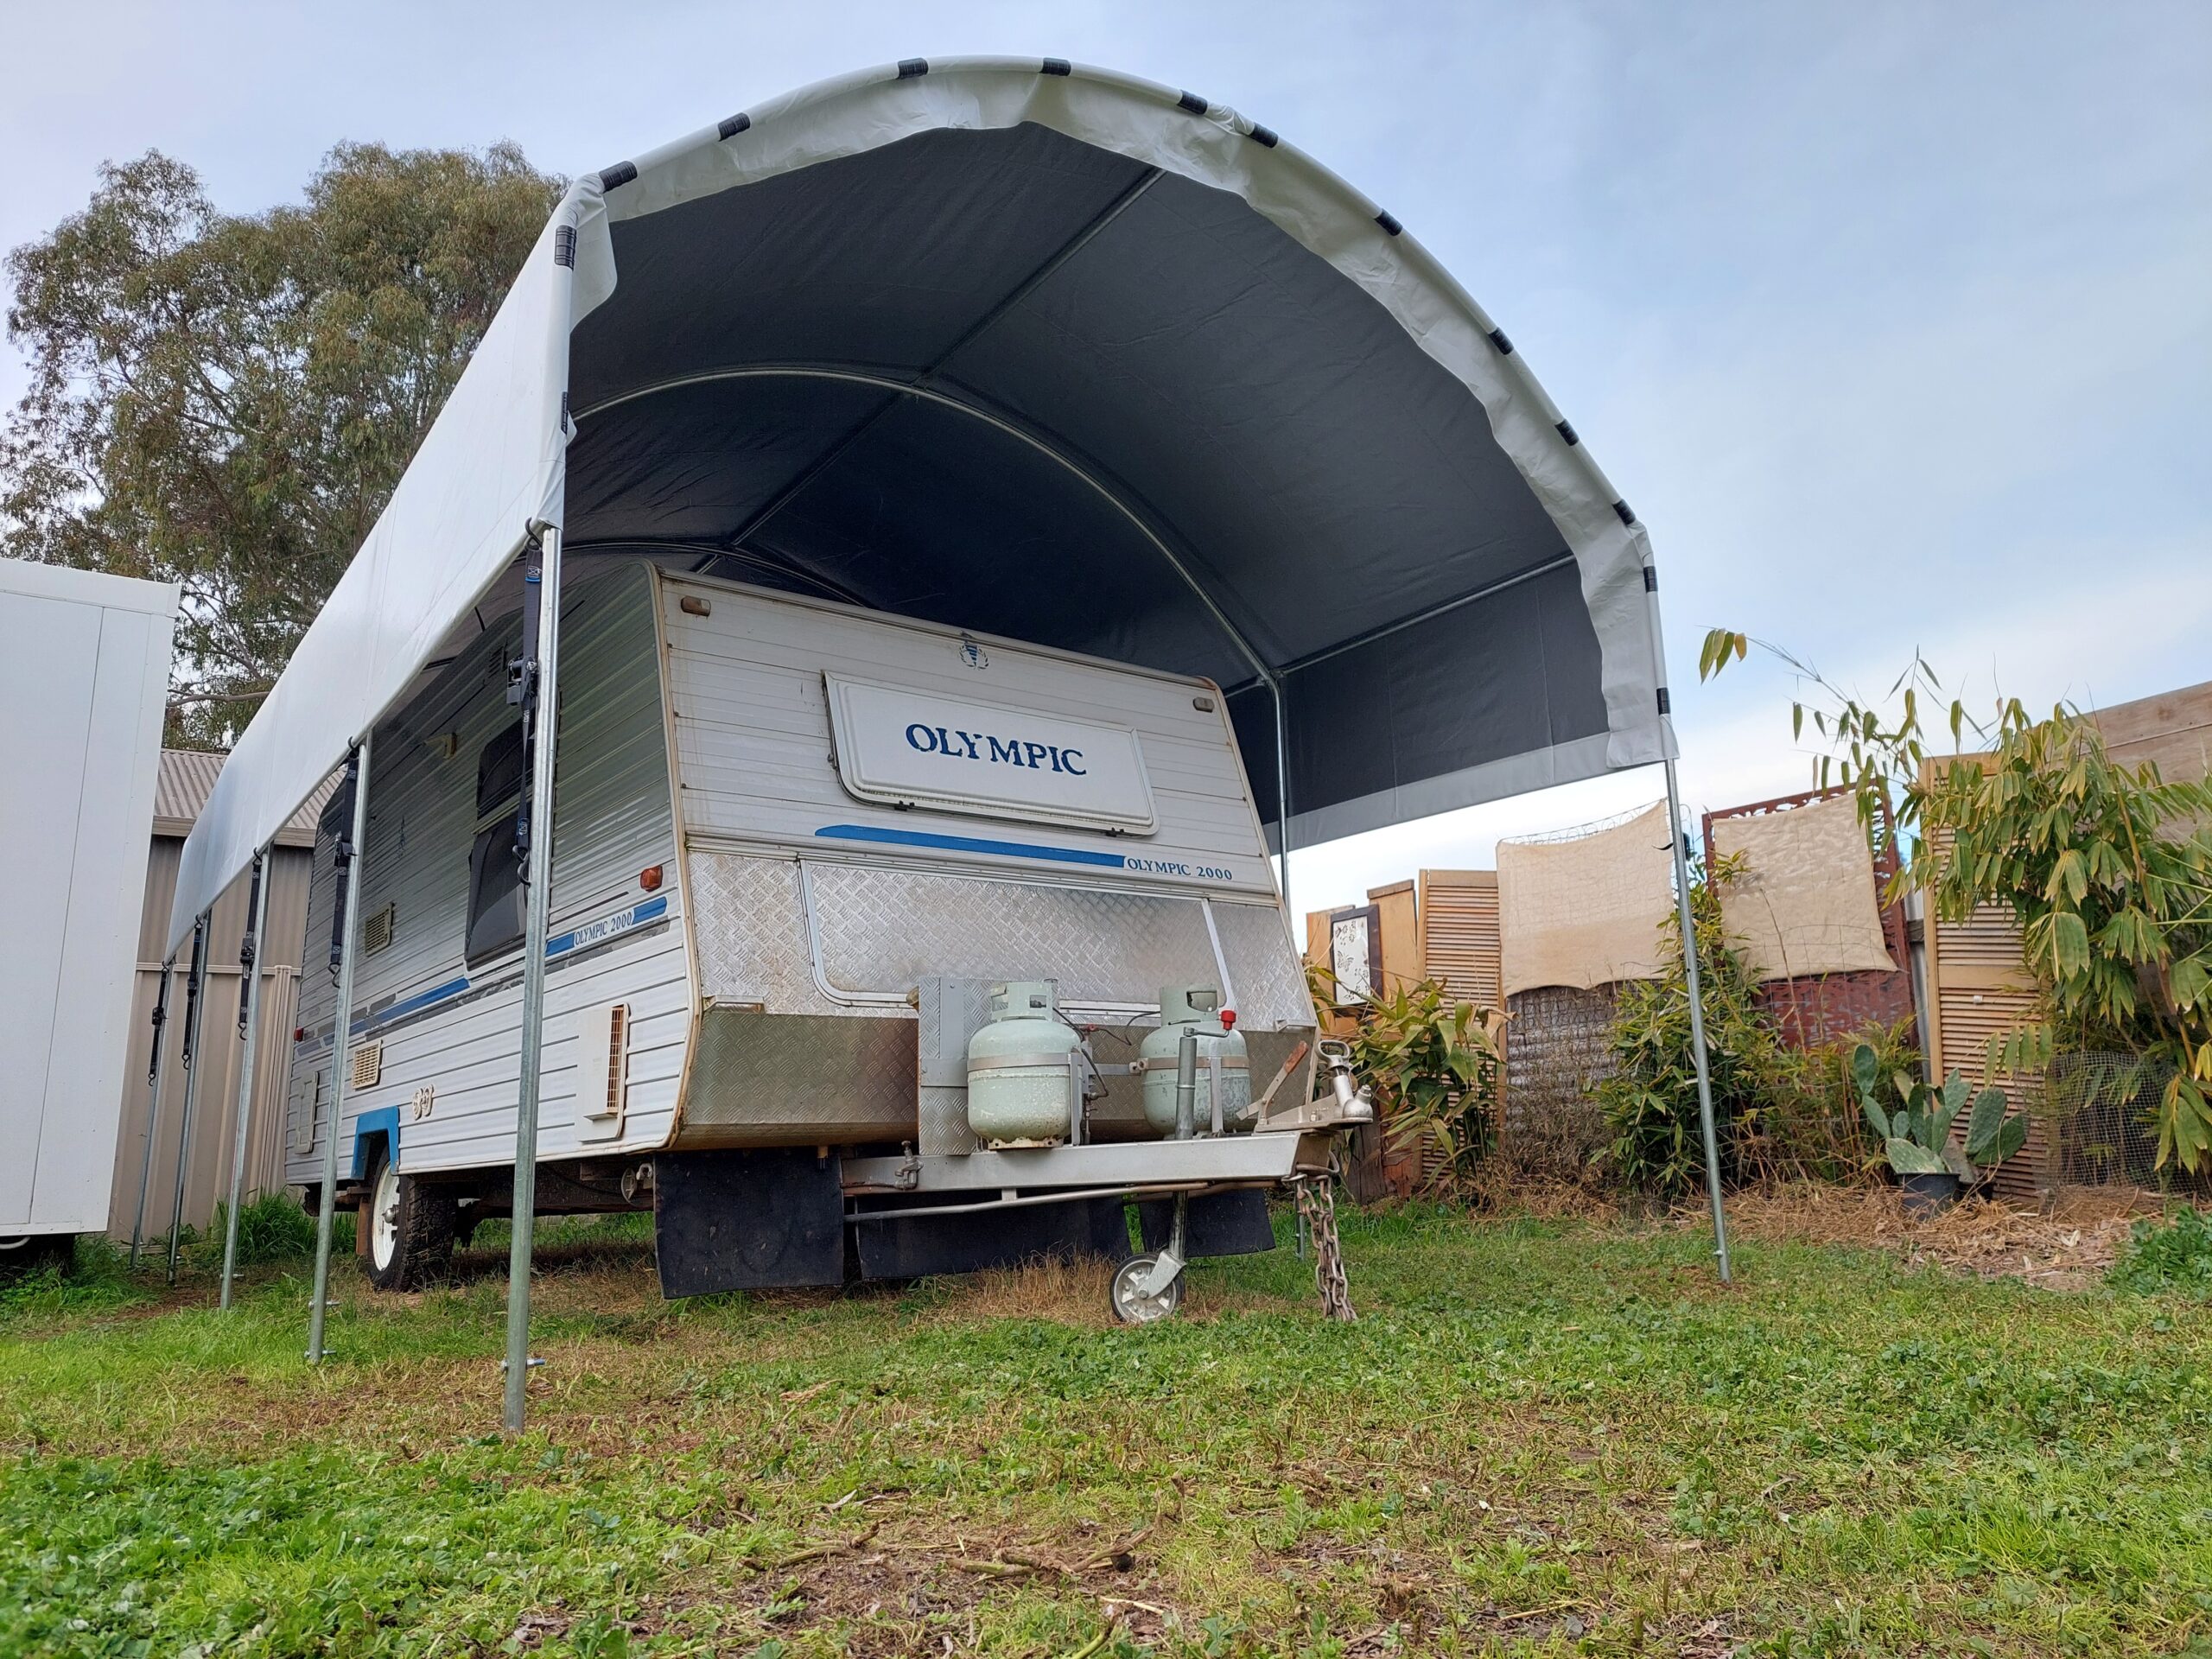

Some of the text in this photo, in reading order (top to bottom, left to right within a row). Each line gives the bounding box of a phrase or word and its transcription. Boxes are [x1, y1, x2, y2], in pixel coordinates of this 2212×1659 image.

[906, 723, 1087, 776] OLYMPIC
[1127, 858, 1233, 880] OLYMPIC 2000
[575, 911, 632, 945] OLYMPIC 2000
